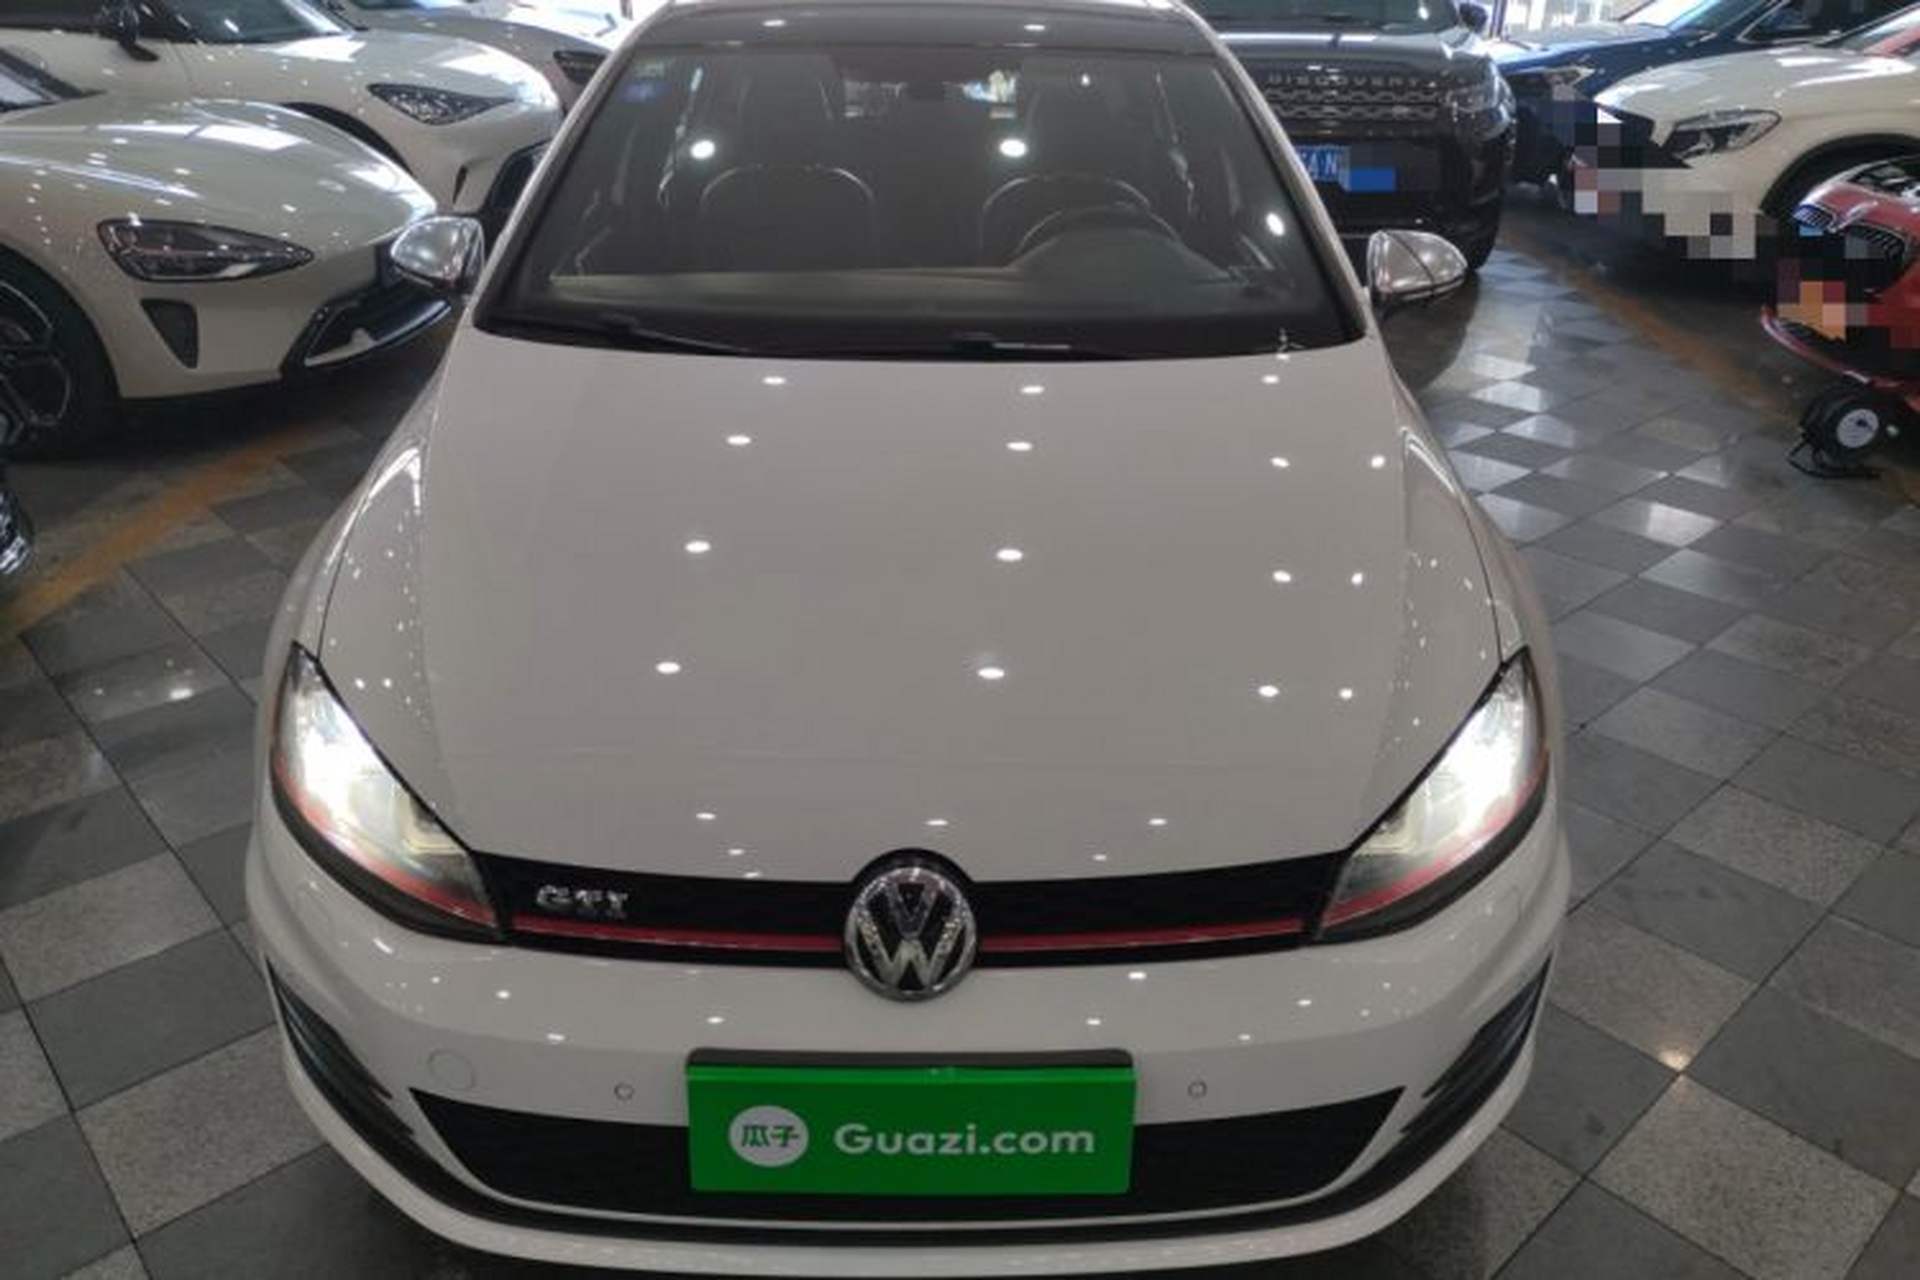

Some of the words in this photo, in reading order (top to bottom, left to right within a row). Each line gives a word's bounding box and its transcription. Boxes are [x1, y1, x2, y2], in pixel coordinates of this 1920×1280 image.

[536, 885, 629, 918] GTI
[741, 1124, 799, 1148] 瓜子
[834, 1122, 1095, 1155] Guazi.com
